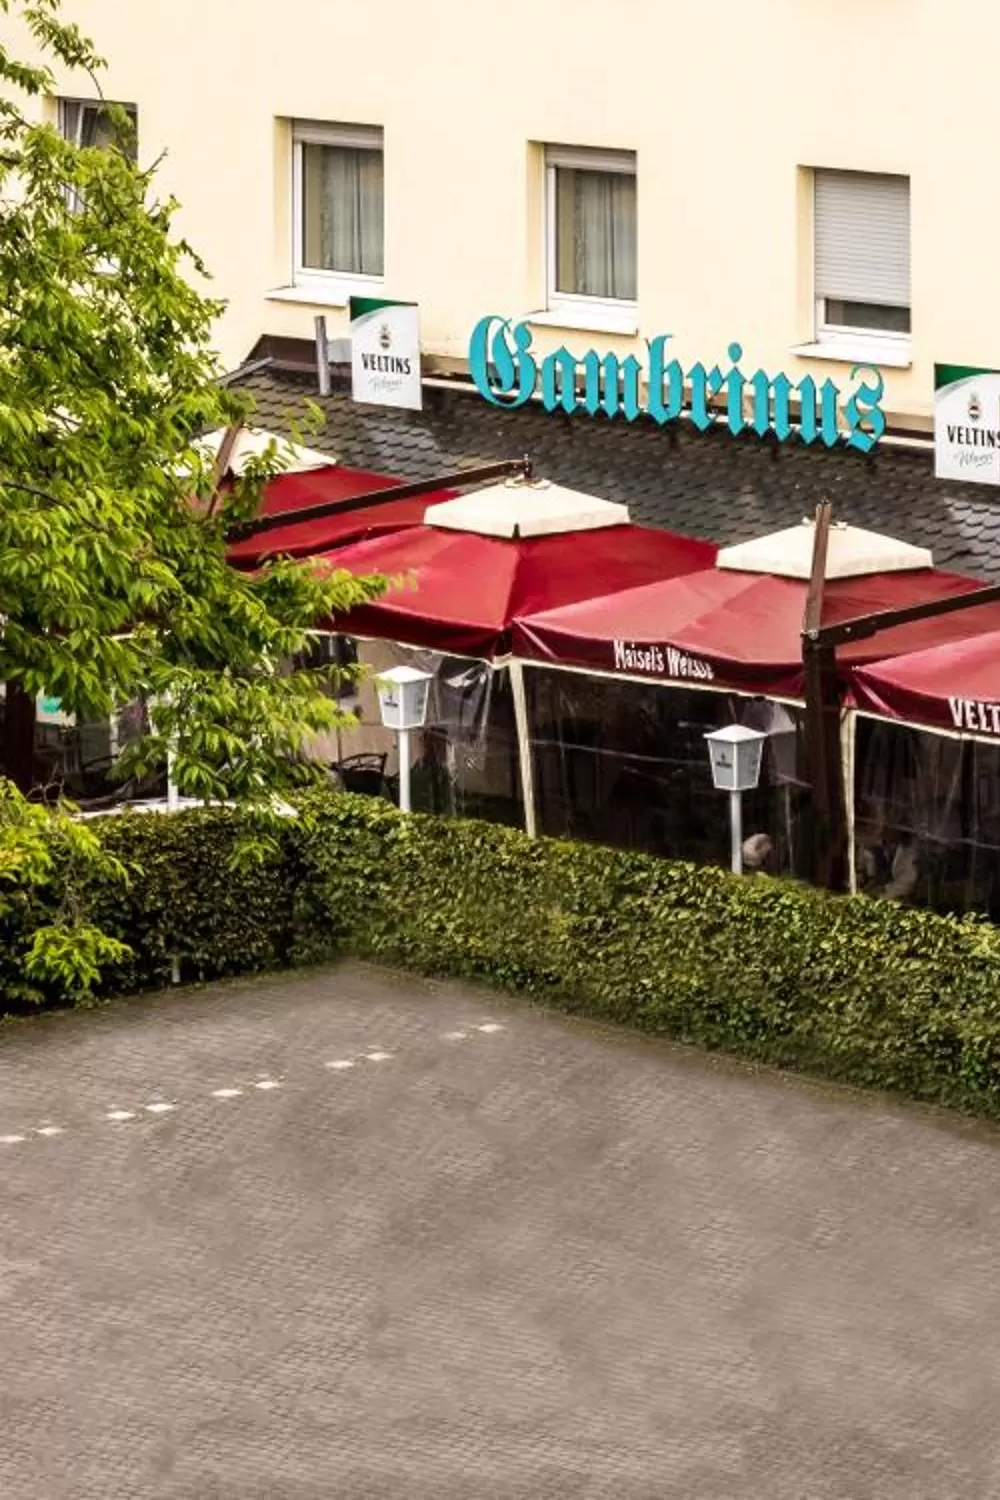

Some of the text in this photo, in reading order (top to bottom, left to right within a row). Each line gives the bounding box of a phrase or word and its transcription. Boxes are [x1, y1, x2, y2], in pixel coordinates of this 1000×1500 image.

[361, 352, 411, 375] VELTINS
[467, 314, 887, 454] Gambrinus
[613, 639, 665, 673] Maisel's
